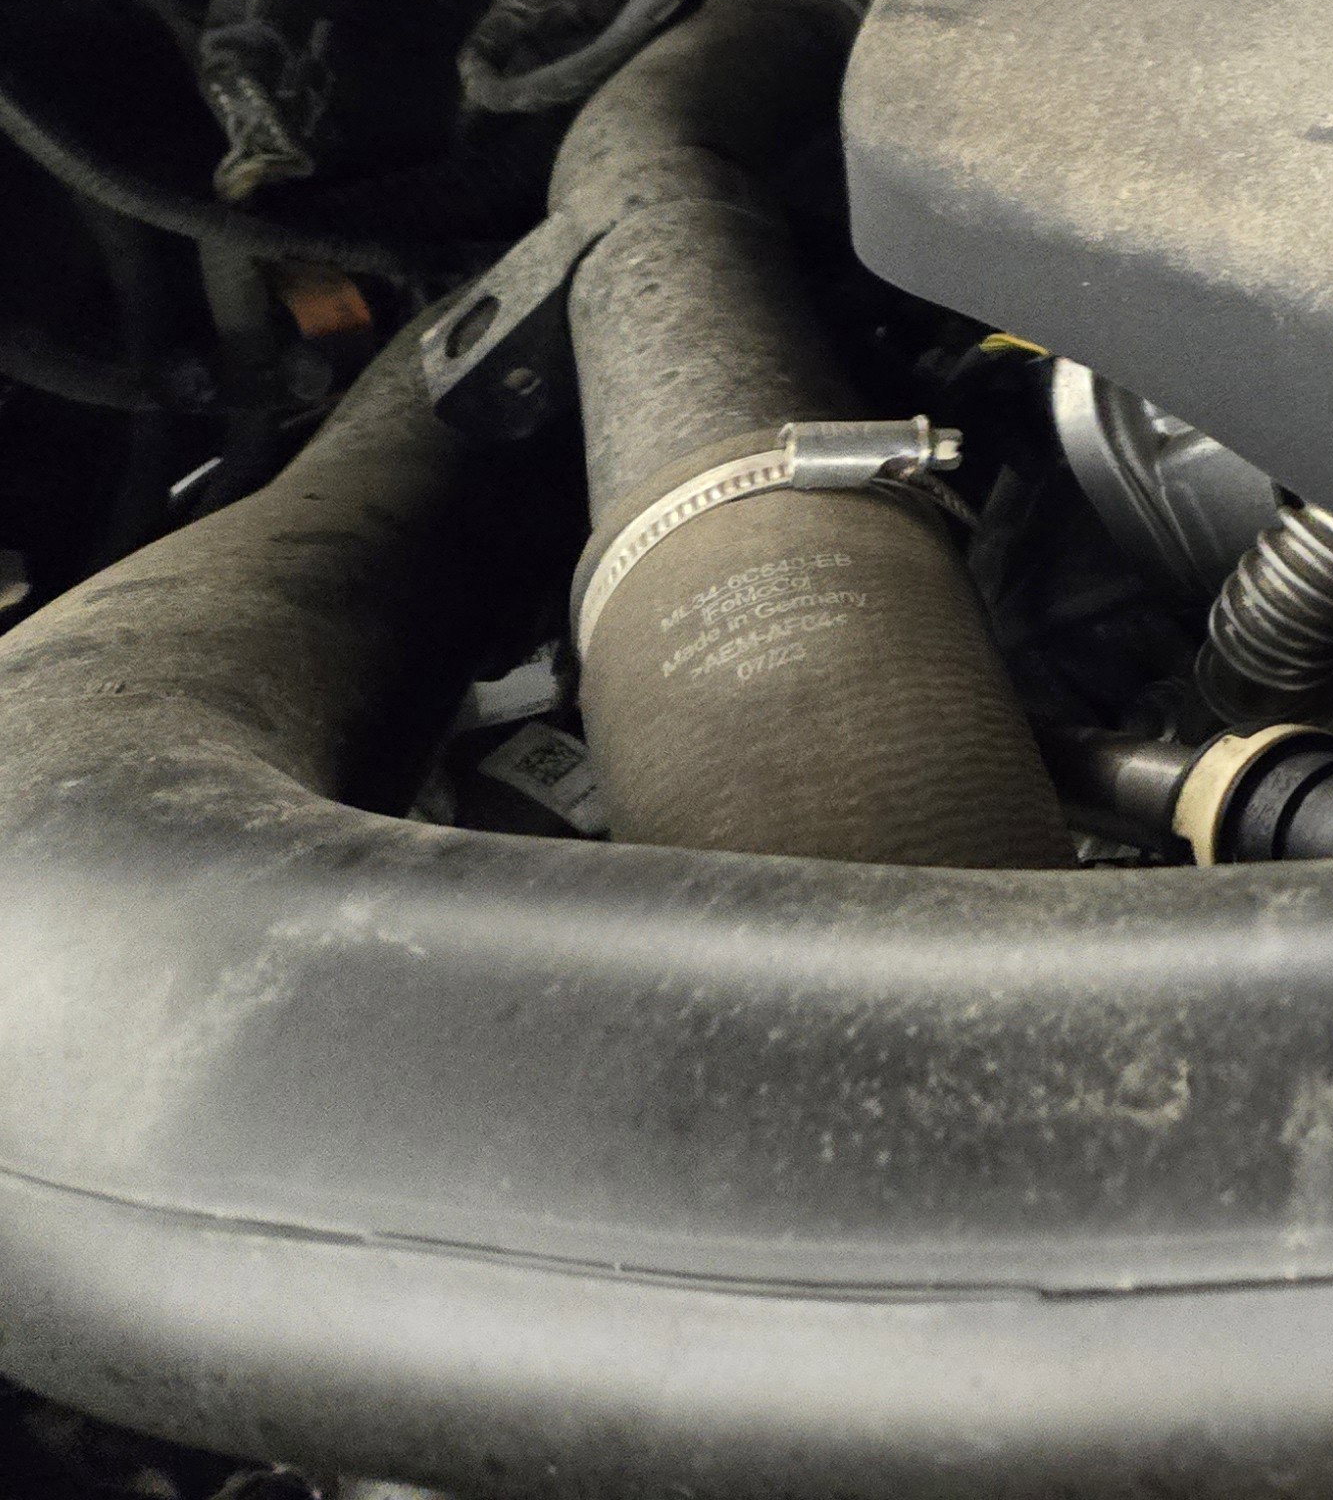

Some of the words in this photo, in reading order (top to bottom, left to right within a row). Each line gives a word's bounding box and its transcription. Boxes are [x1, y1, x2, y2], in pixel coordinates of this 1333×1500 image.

[660, 627, 721, 678] Made
[727, 613, 749, 632] in
[754, 591, 868, 619] Germany
